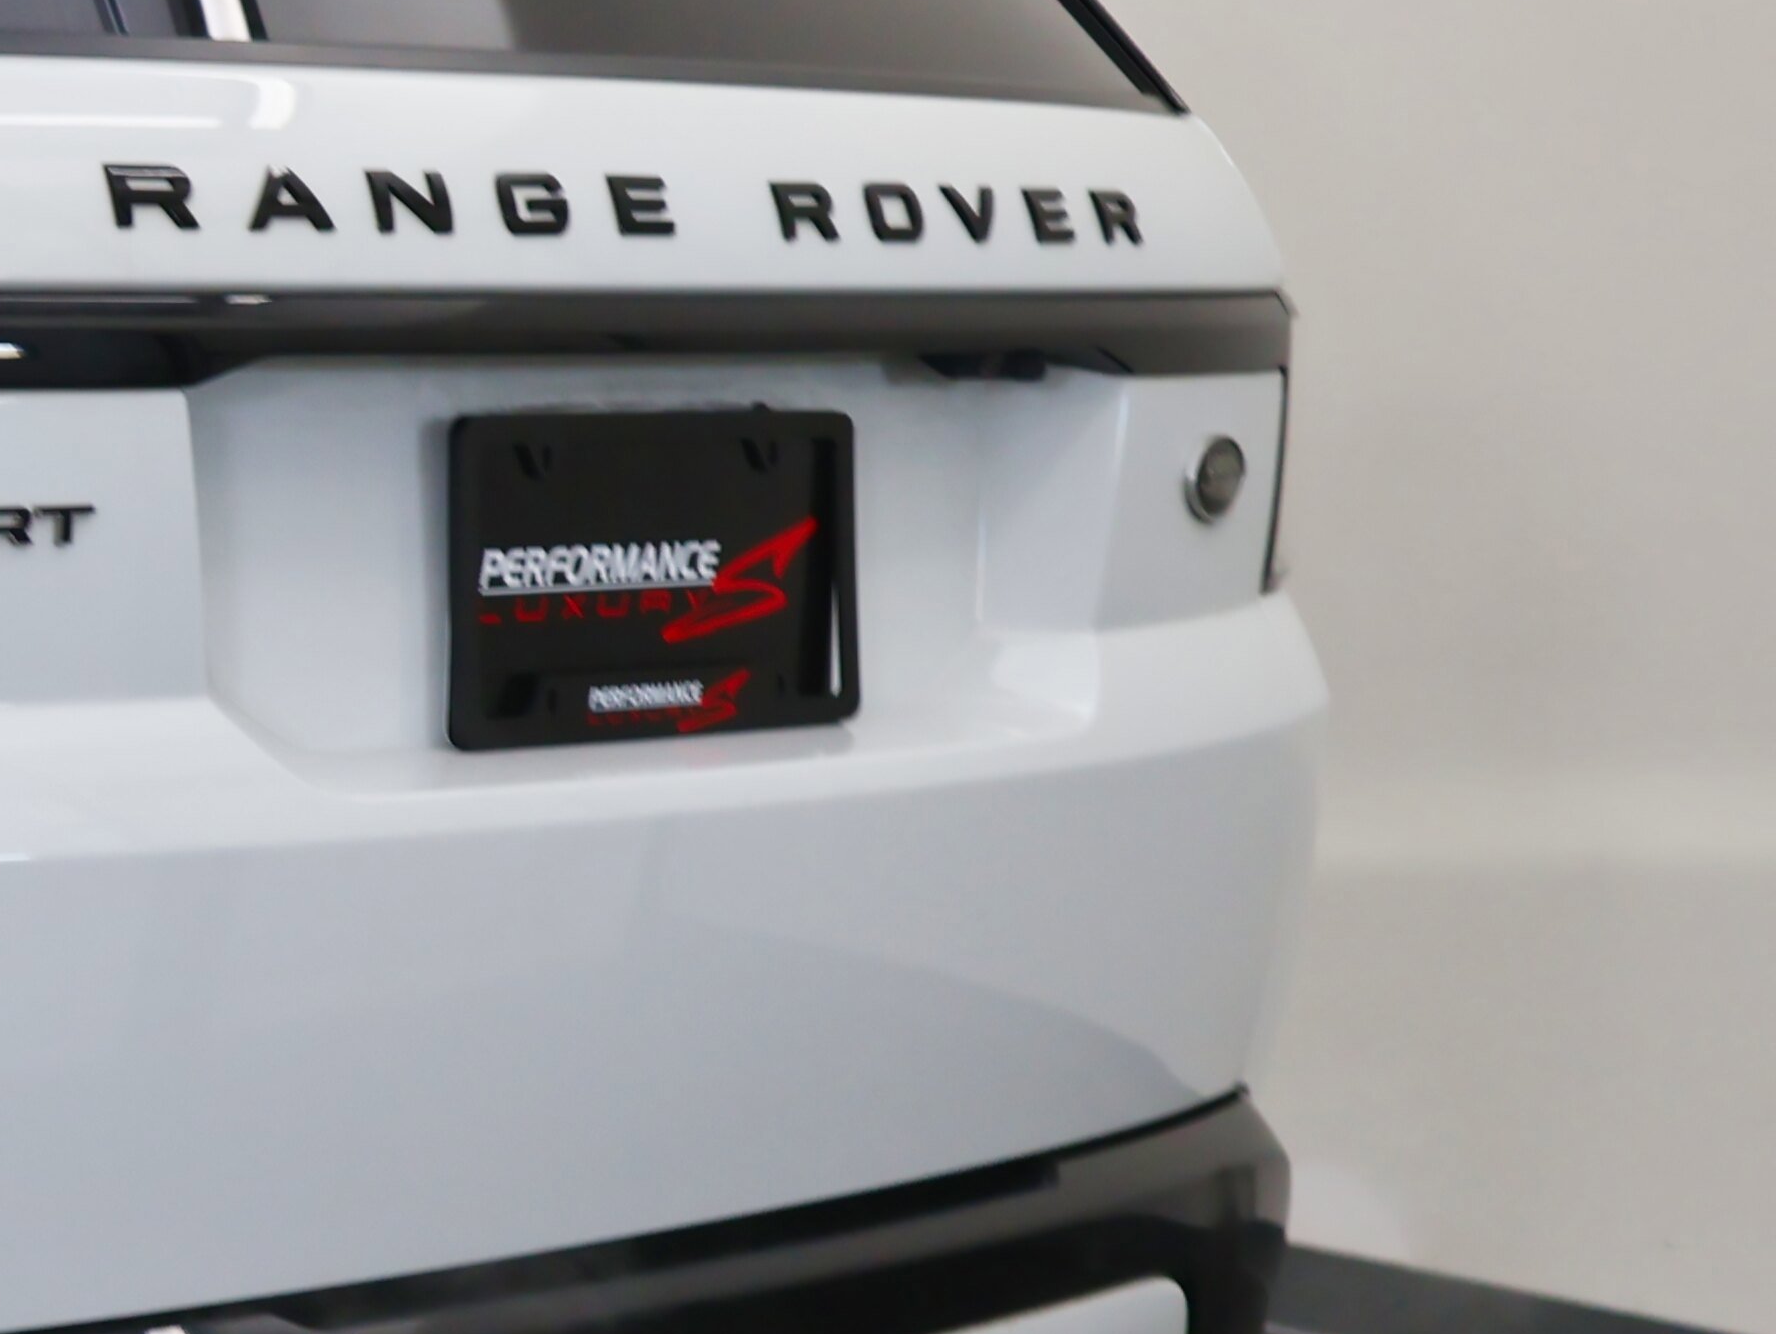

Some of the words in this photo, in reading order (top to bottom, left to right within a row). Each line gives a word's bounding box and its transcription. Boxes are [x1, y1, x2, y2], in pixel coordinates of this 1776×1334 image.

[103, 163, 676, 236] RANGE
[768, 179, 1144, 245] ROVER
[479, 540, 721, 589] PERFORMANCE
